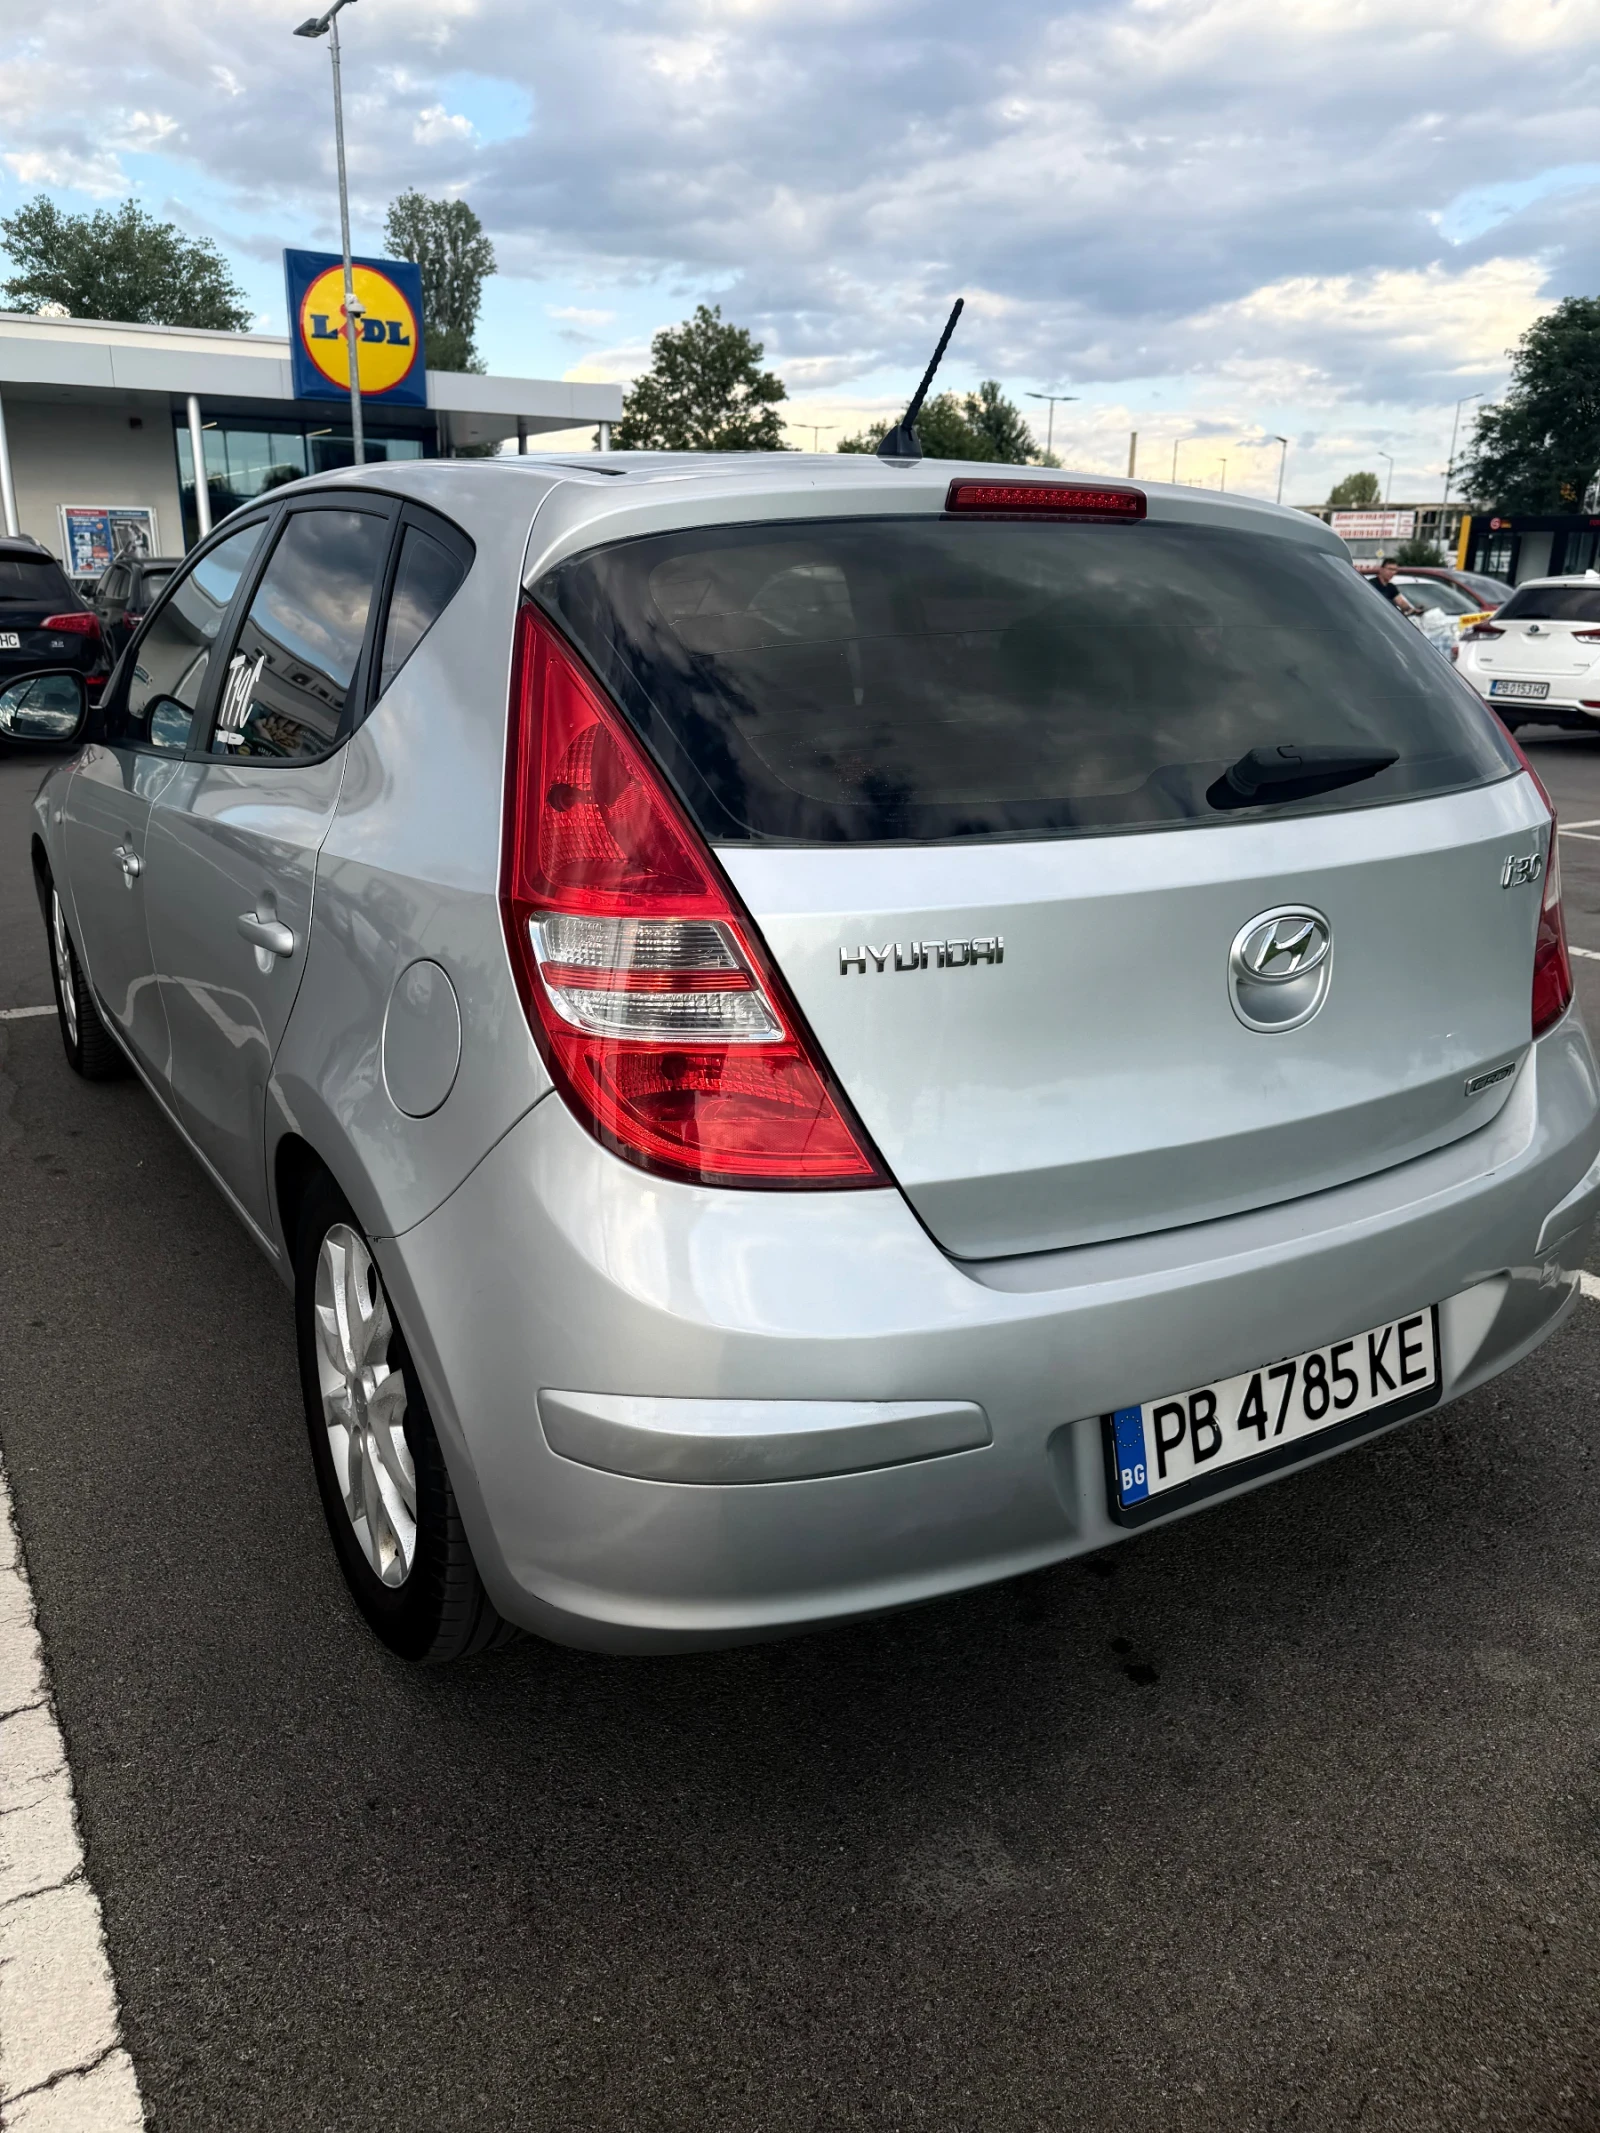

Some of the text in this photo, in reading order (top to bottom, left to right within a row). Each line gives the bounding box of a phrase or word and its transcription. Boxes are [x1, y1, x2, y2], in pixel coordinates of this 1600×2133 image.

[1501, 853, 1542, 889] i30
[840, 936, 1004, 976] HYUNDAI
[1152, 1315, 1428, 1479] PB 4785 KE
[1121, 1463, 1145, 1491] BG
